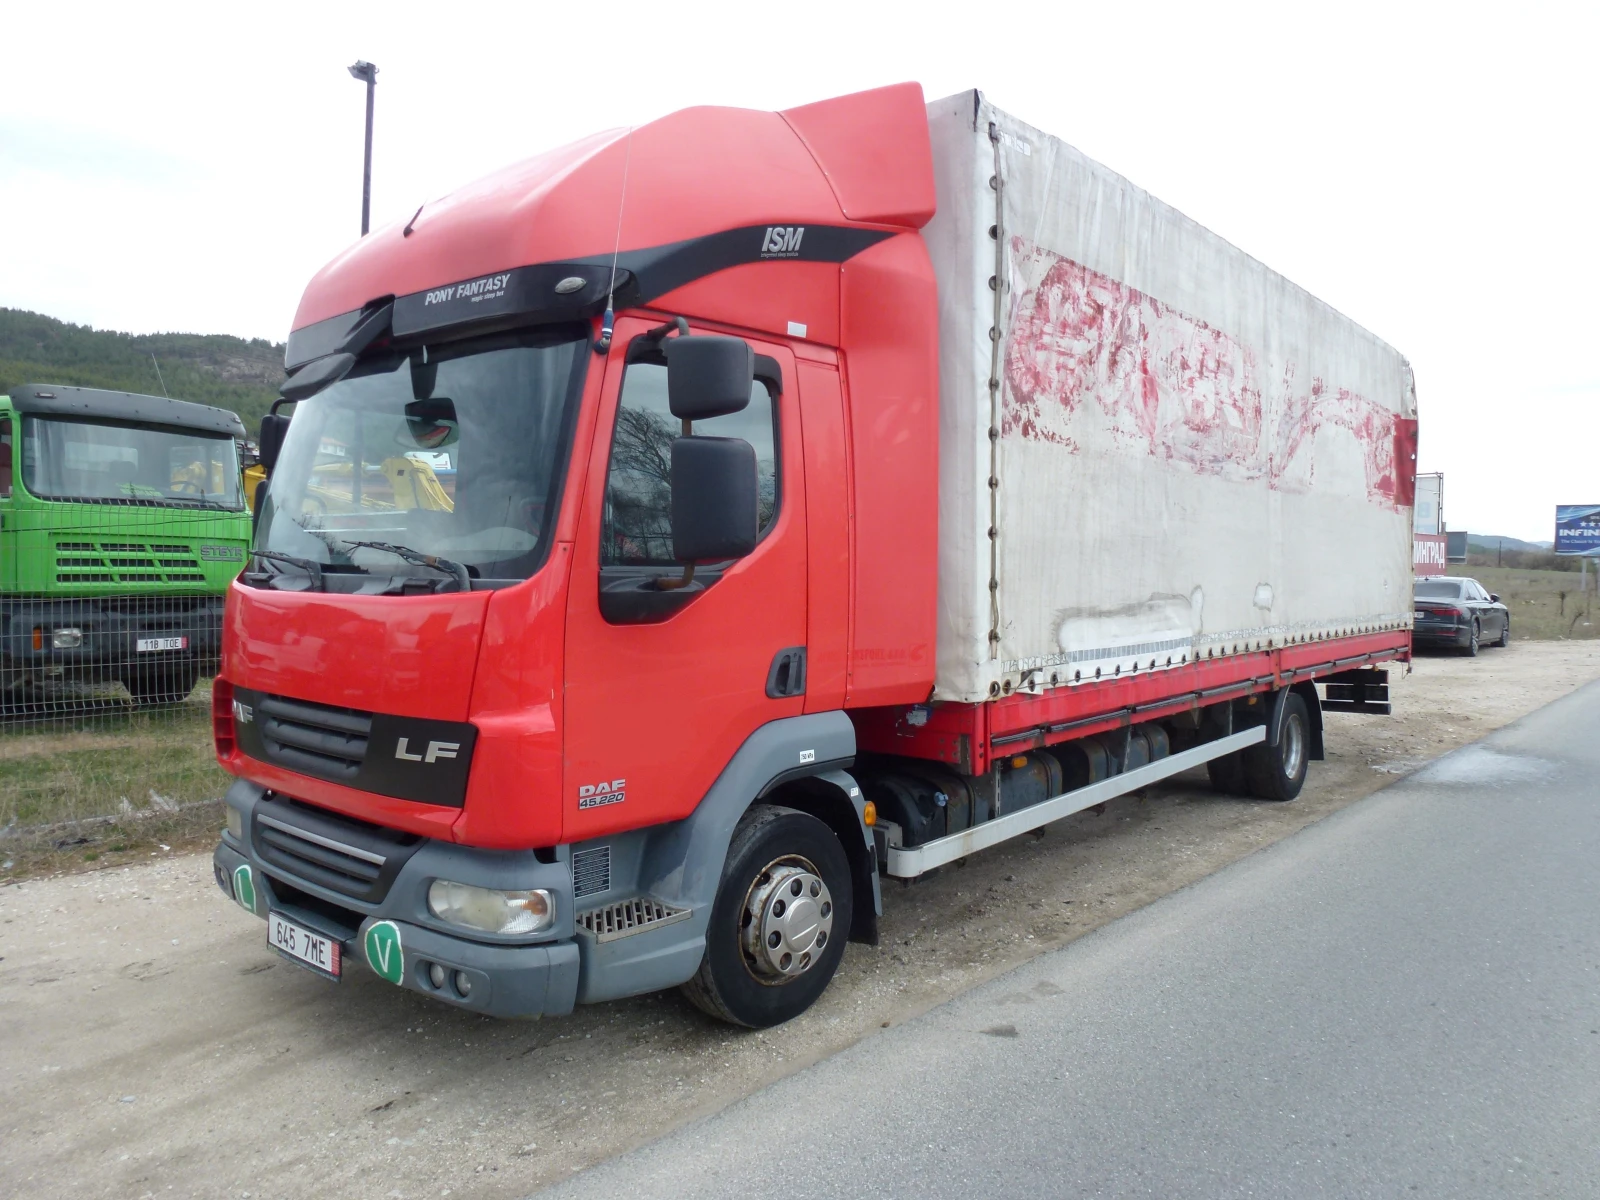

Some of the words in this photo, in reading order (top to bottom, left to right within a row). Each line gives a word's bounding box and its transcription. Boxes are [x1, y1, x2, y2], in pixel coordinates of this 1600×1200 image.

[761, 227, 805, 253] ISM
[425, 287, 455, 306] PONY
[456, 273, 511, 299] FANTASY
[201, 545, 242, 557] STEYR
[395, 737, 461, 764] LF
[579, 779, 626, 797] DAF
[580, 792, 624, 808] 45.220
[277, 921, 296, 951] 645
[304, 933, 326, 965] 7ME
[374, 933, 392, 973] V
